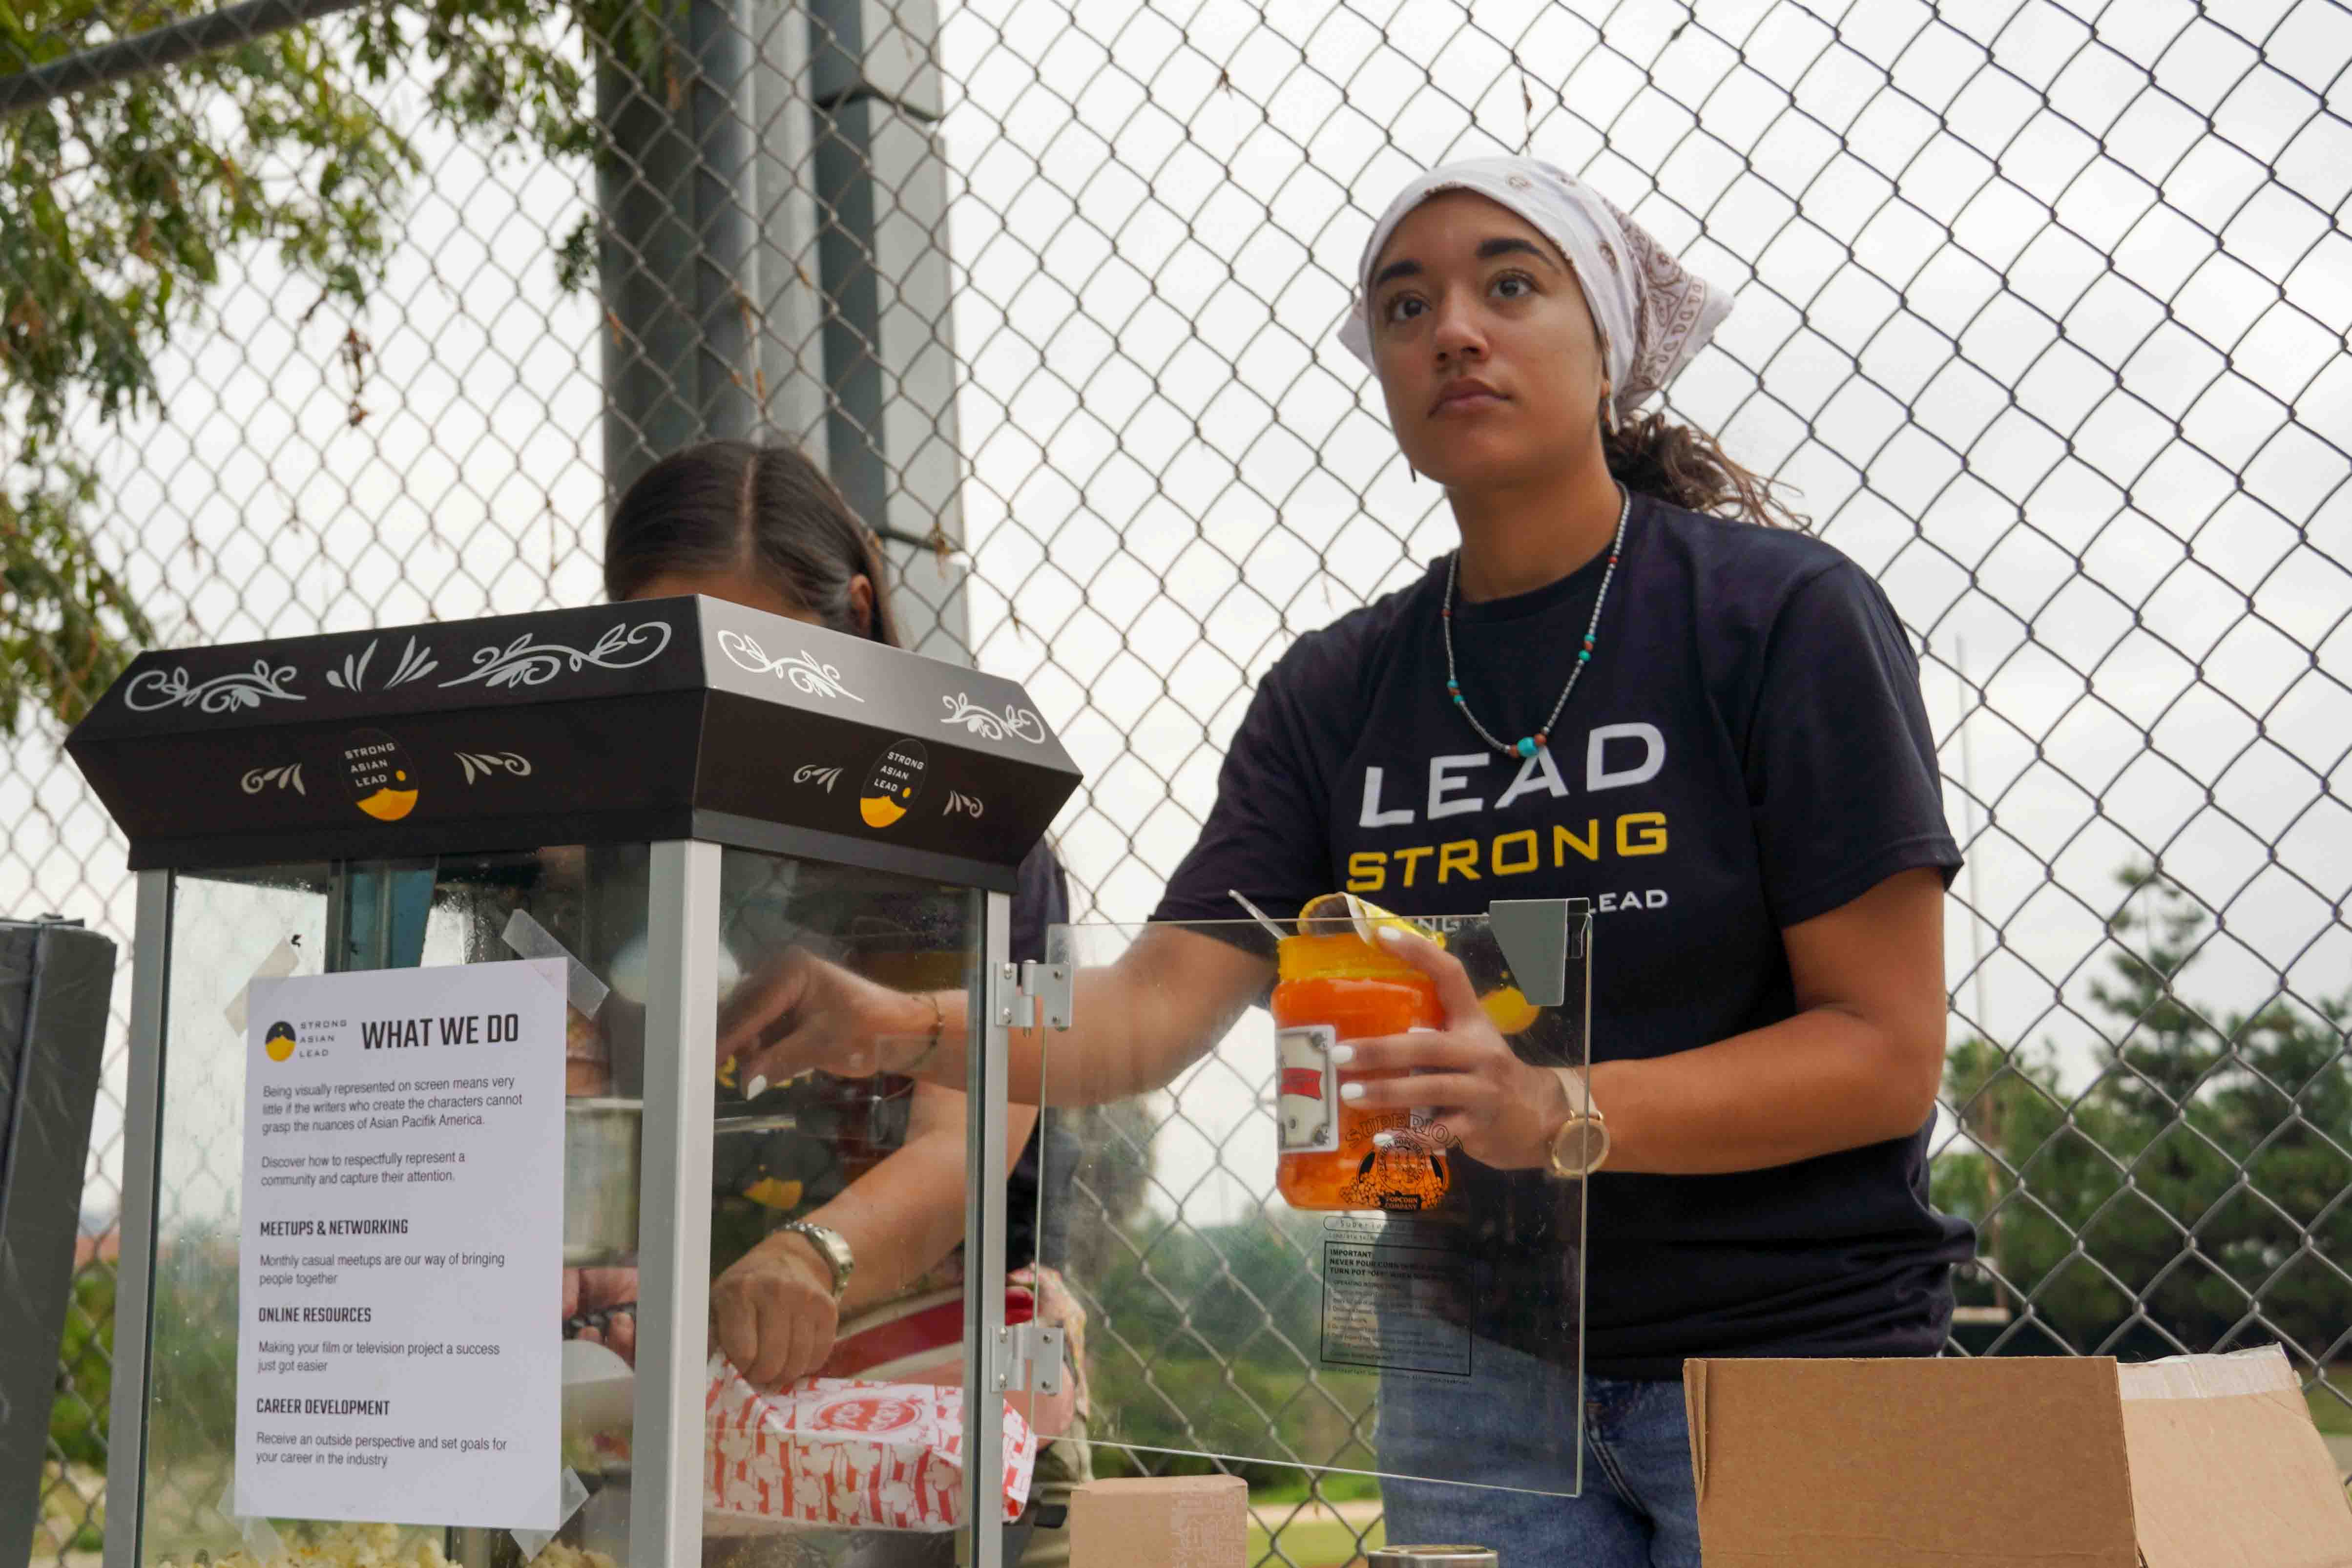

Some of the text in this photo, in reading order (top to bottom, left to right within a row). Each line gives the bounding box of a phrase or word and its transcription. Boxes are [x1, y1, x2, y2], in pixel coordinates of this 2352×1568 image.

[345, 743, 395, 759] STRONG
[350, 759, 388, 774] ASIAN
[887, 752, 924, 770] STRONG
[355, 774, 387, 787] LEAD
[880, 765, 909, 780] ASIAN
[1359, 722, 1666, 828] LEAD
[874, 778, 898, 792] LEAD
[1347, 812, 1668, 893] STRONG
[299, 1019, 347, 1029] STRONG
[362, 1014, 518, 1049] WHAT WE DO
[299, 1034, 335, 1044] ASIAN
[299, 1049, 329, 1058] LEAD
[263, 1077, 515, 1100] Being visually represented on screen means very
[262, 1093, 522, 1115] little if the writers who create the characters cannot
[261, 1113, 485, 1136] grasp the nuances of Asian Pacifik America.
[261, 1151, 465, 1169] Discover how to respectfully represent a
[261, 1169, 455, 1188] community and capture their attention.
[260, 1218, 408, 1236] MEETUPS & NETWORKING
[260, 1252, 505, 1269] Monthly casual meetups are our way of bringing
[259, 1272, 338, 1288] people together
[259, 1307, 371, 1322] ONLINE RESOURCES
[258, 1339, 500, 1358] Making your film or television project a success
[257, 1359, 329, 1375] just got easier
[256, 1398, 390, 1416] CAREER DEVELOPMENT
[256, 1431, 507, 1453] Receive an outside perspective and set goals for
[256, 1452, 388, 1469] your career in the industry
